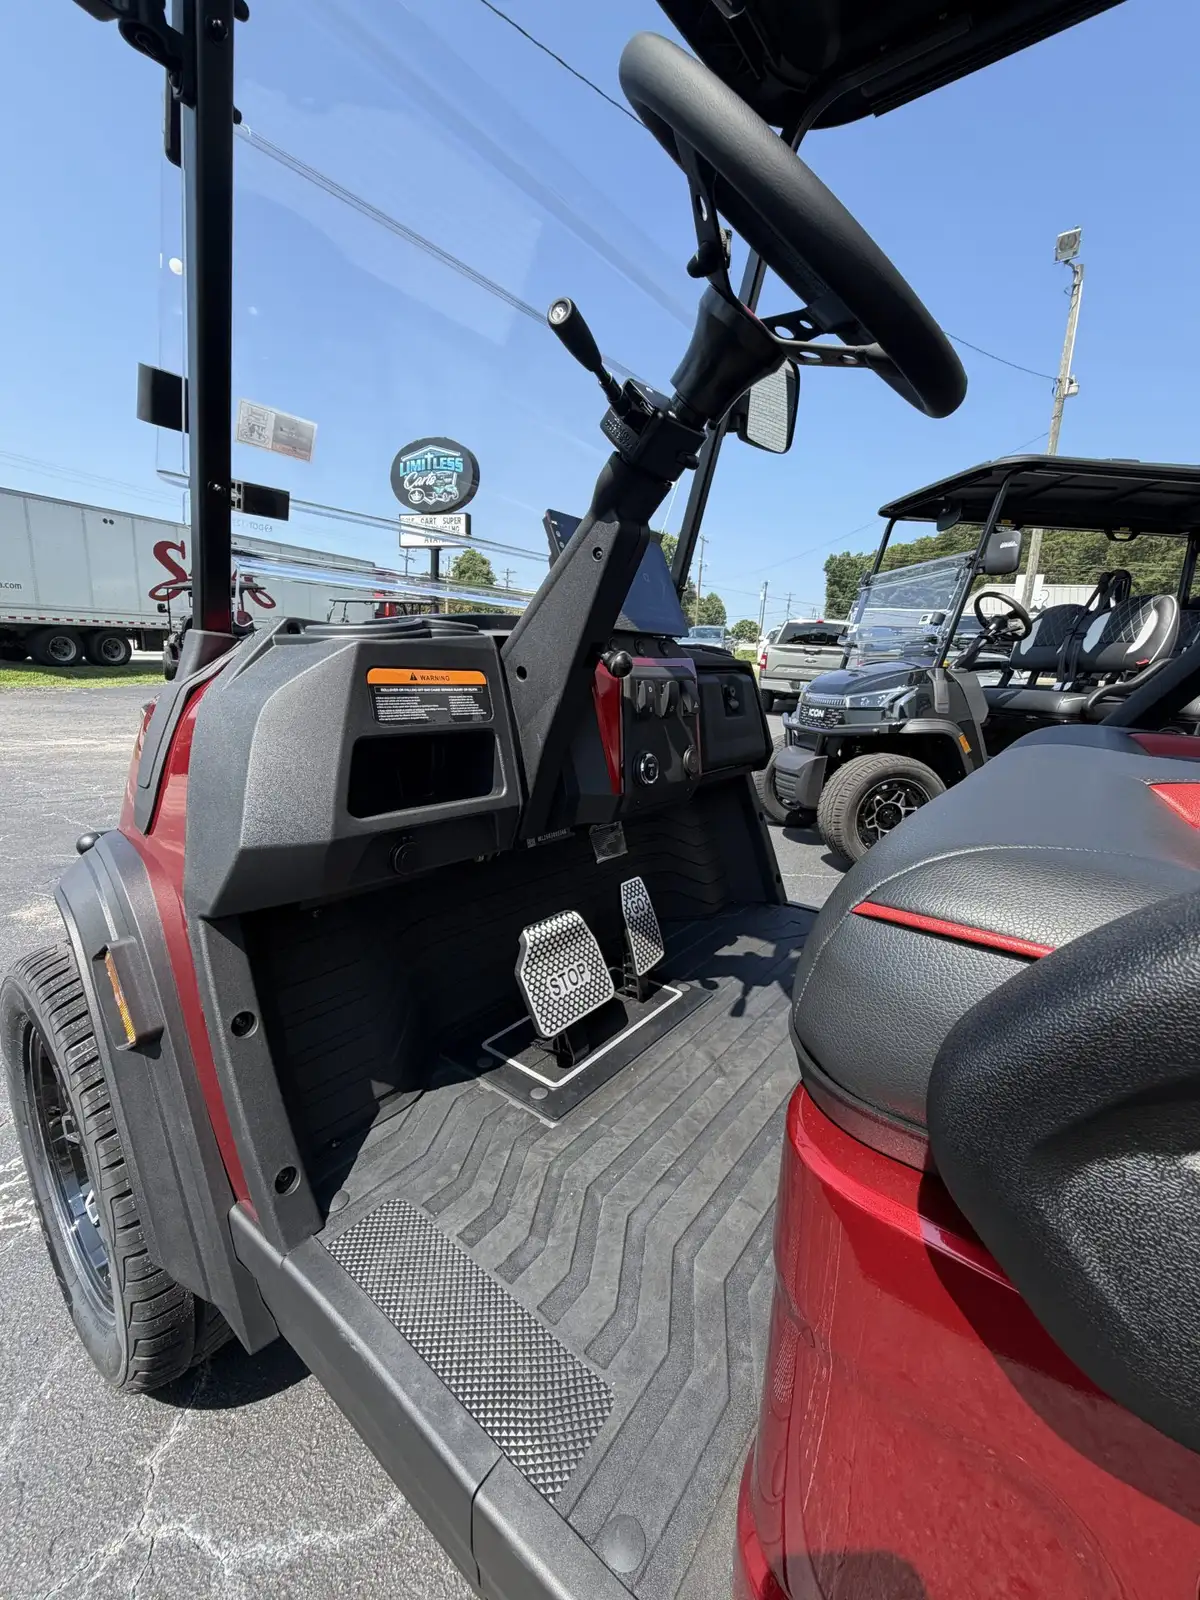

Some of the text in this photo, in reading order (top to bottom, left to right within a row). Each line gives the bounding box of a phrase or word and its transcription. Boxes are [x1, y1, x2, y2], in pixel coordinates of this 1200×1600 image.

[400, 452, 463, 477] LIMITLESS
[403, 472, 437, 489] Carts
[420, 516, 437, 525] CART
[442, 516, 461, 525] SUPER
[419, 674, 450, 682] WARNING
[808, 708, 825, 718] ICON
[630, 898, 646, 915] GO
[550, 962, 588, 997] STOP
